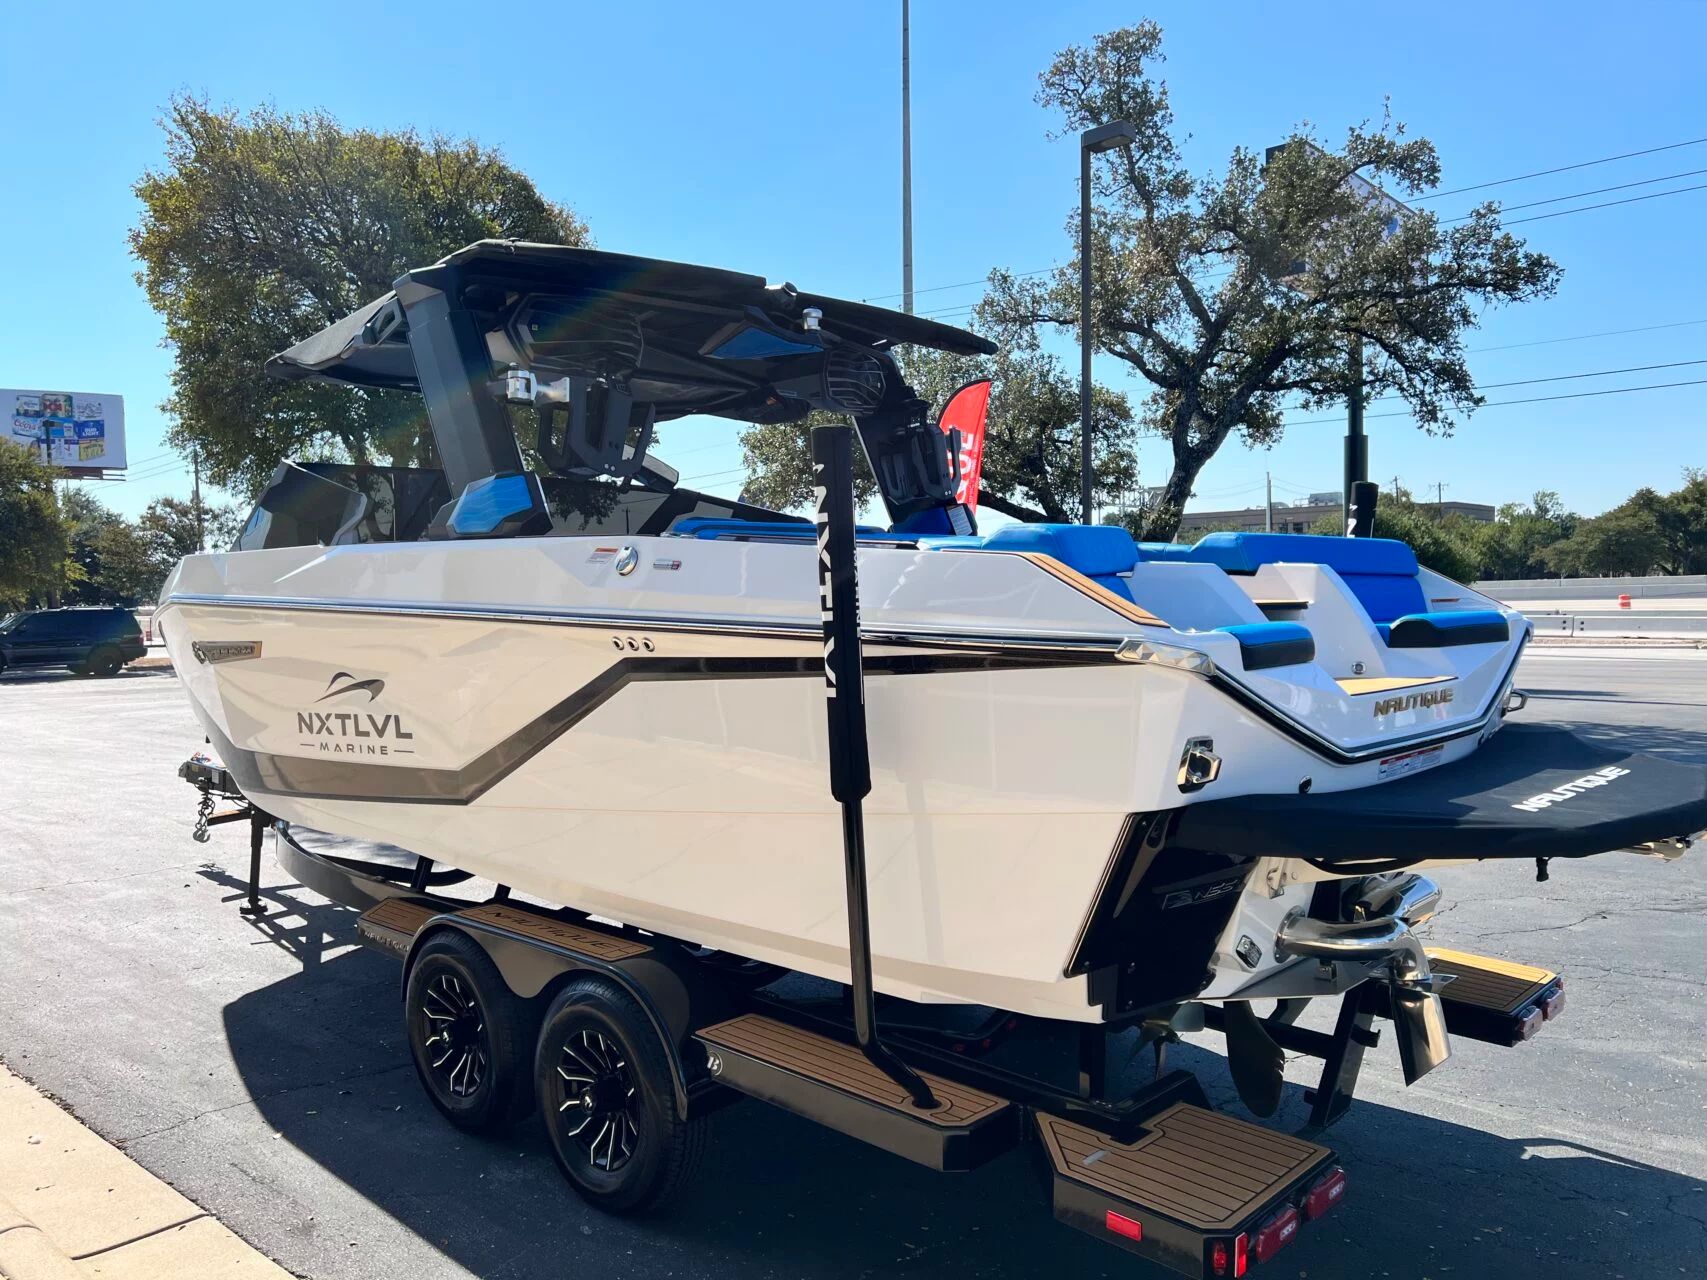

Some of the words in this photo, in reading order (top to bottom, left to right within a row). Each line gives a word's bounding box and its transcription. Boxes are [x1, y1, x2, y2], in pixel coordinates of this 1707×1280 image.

[1373, 688, 1454, 717] NAUTIQUE
[297, 712, 413, 740] NXTLVL
[320, 742, 389, 756] MARINE
[1511, 766, 1631, 812] NAUTIQUE
